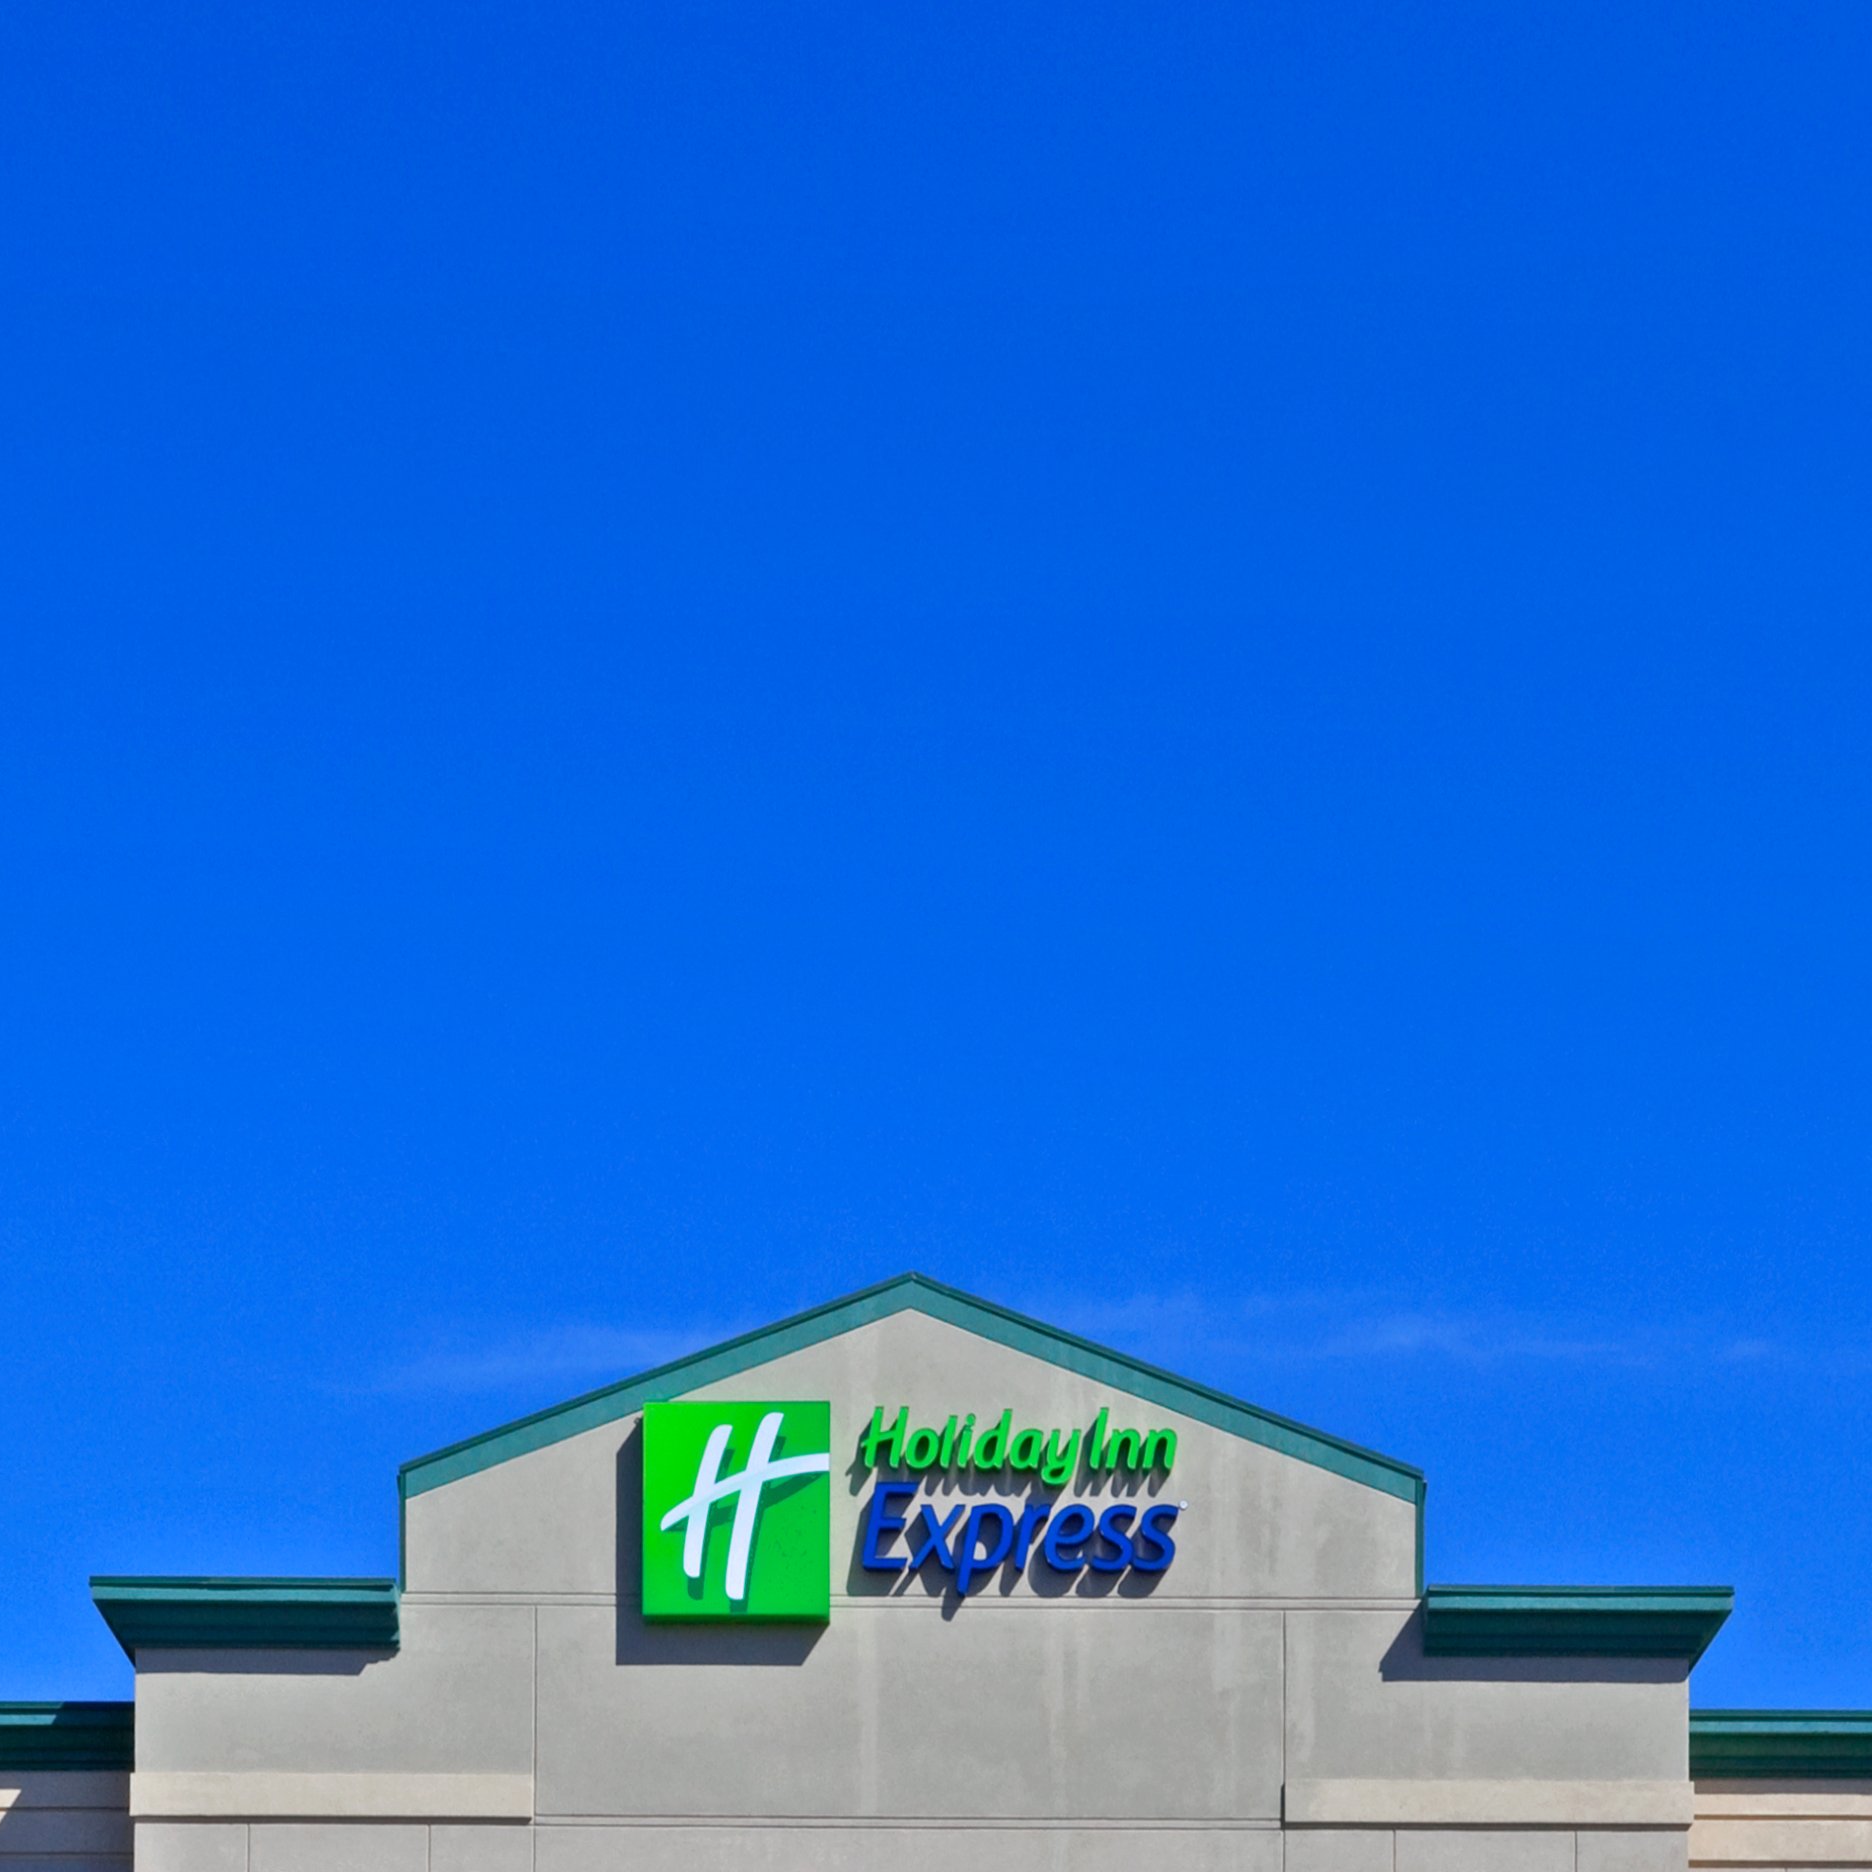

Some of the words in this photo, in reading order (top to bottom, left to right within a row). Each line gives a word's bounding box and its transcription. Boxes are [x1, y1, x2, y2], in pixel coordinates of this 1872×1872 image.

[860, 1406, 1082, 1485] Holiday
[1089, 1407, 1178, 1471] Inn
[660, 1411, 829, 1600] H
[861, 1481, 1179, 1597] Express
